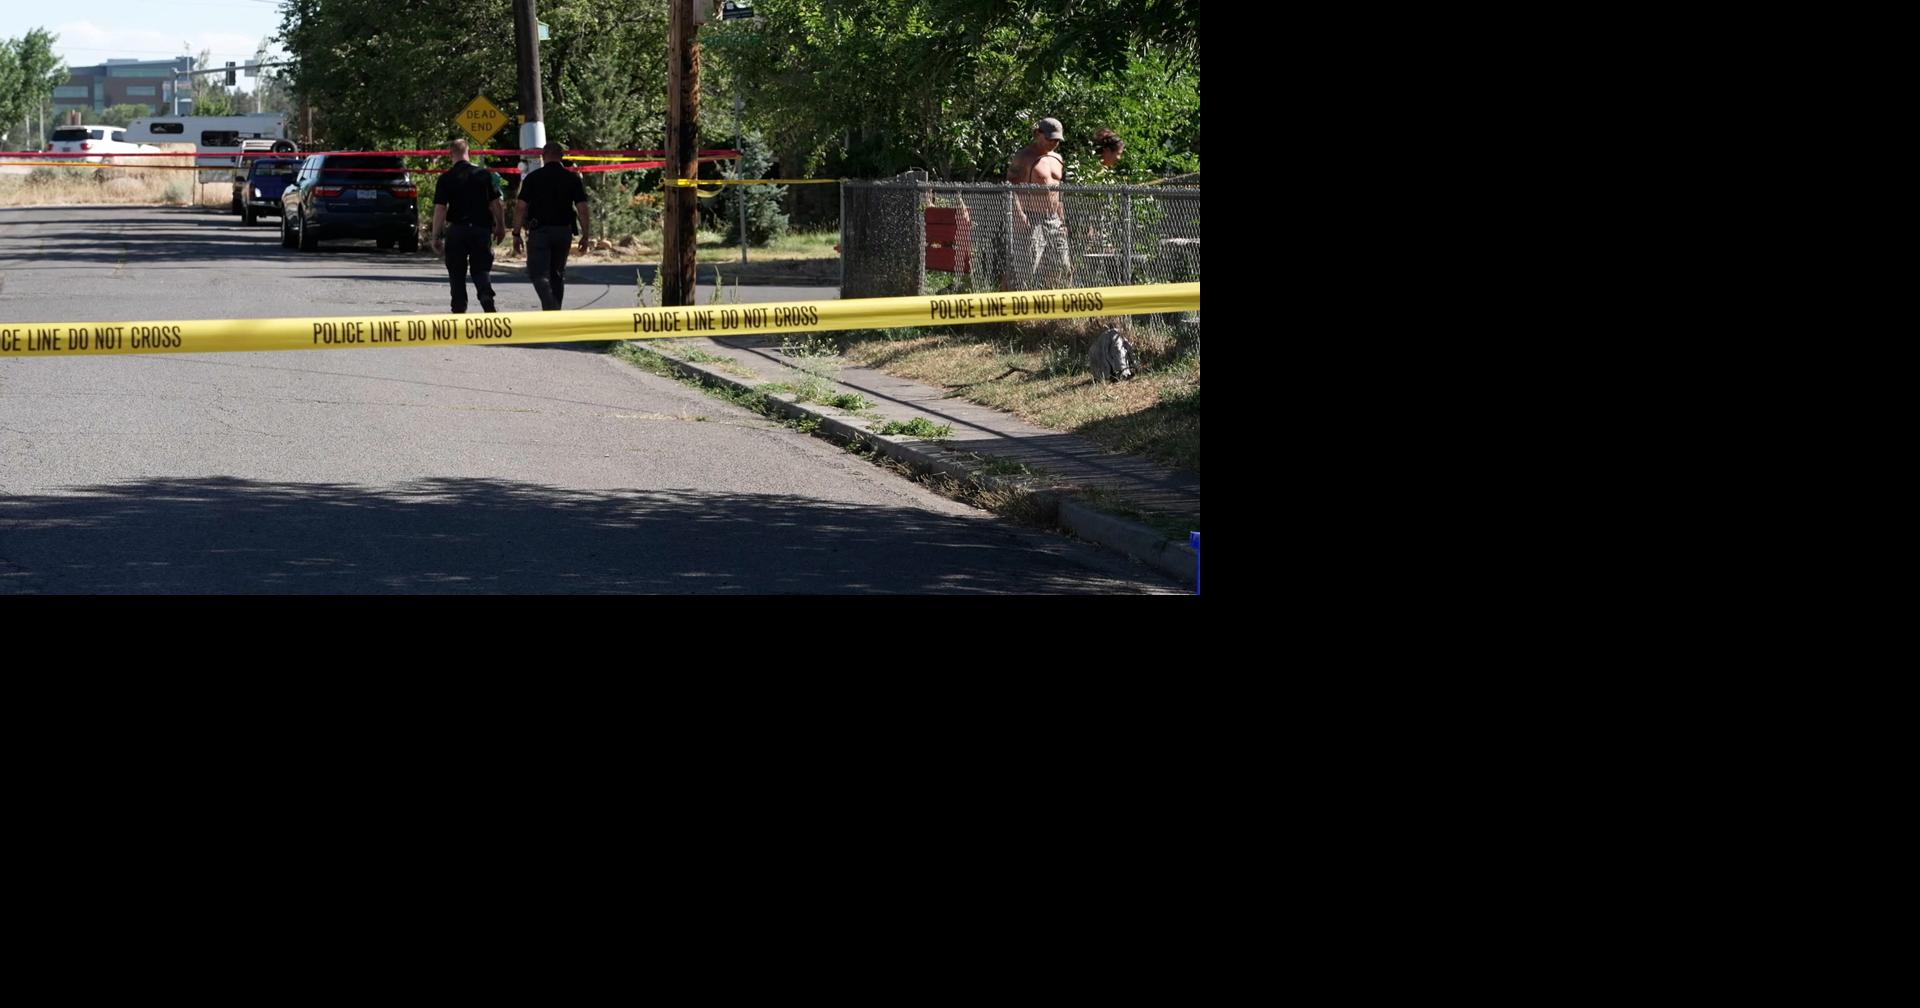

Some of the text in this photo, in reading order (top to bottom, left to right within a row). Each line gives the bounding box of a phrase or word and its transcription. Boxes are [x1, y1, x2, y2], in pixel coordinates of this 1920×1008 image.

[466, 109, 497, 119] DEAD
[471, 122, 493, 132] END
[633, 306, 819, 333] POLICE LINE DO NOT CROSS
[931, 293, 1103, 320] POLICE LINE DO NOT CROSS
[28, 328, 62, 352] LINE
[68, 328, 89, 350] DO
[95, 327, 124, 350] NOT
[131, 326, 182, 349] CROSS
[313, 318, 513, 345] POLICE LINE DO NOT CROSS
